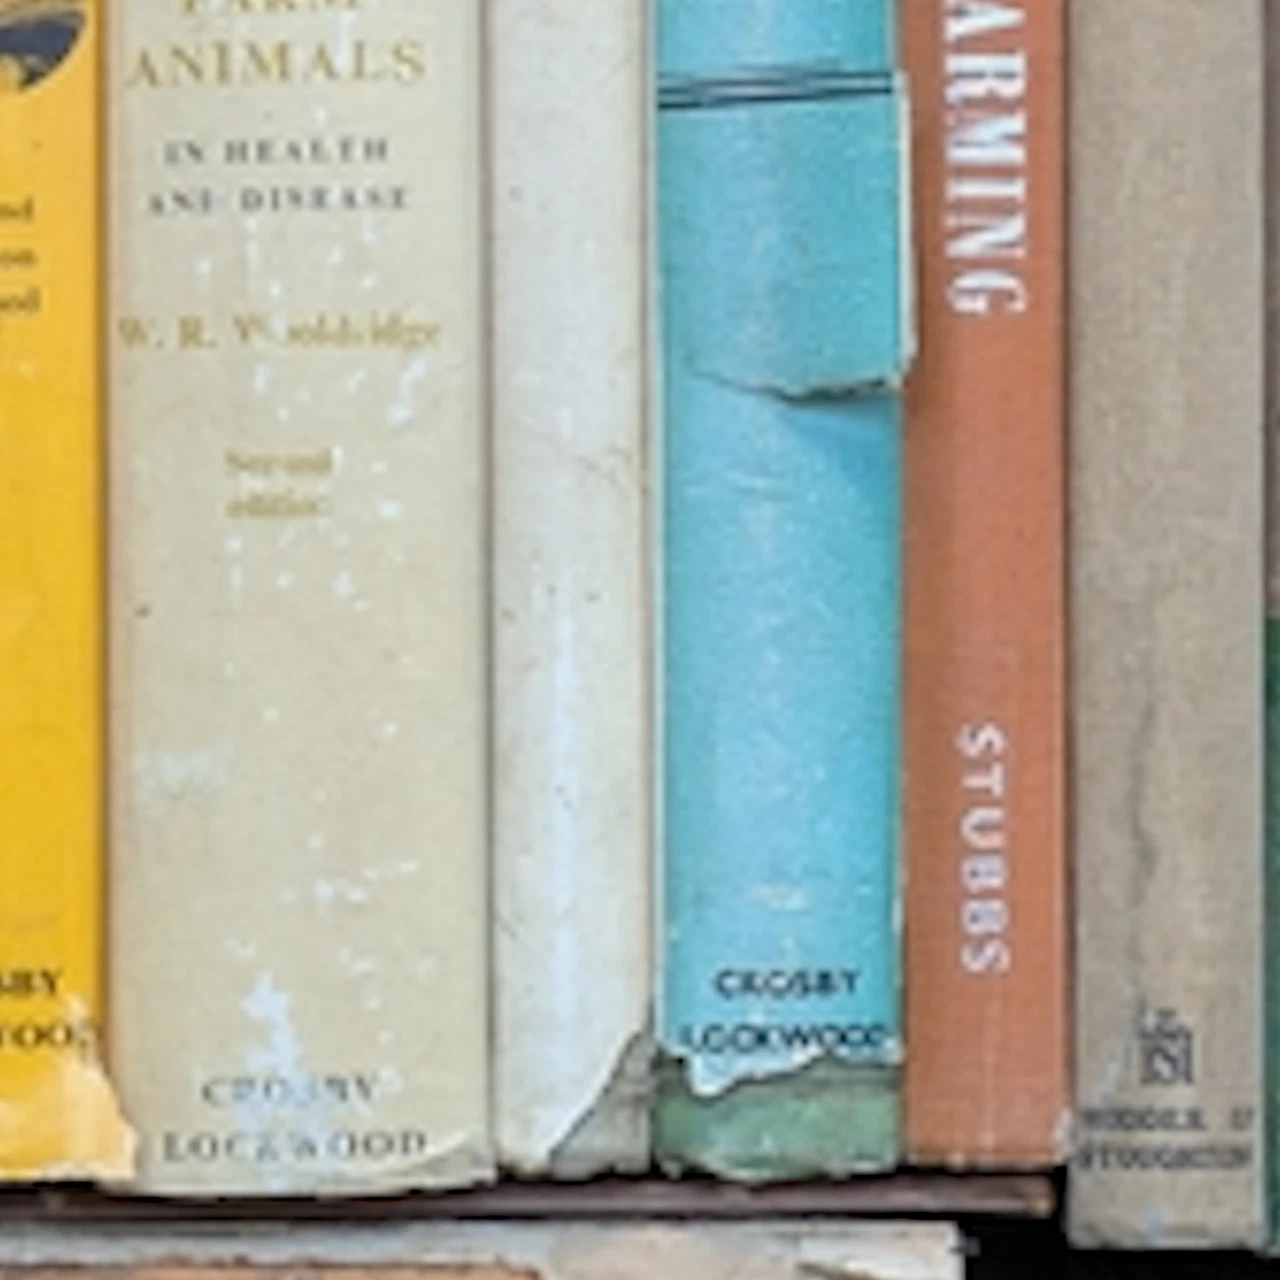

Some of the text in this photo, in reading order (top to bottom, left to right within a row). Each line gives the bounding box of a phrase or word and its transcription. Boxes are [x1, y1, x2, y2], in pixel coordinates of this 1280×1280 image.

[124, 39, 428, 89] ANIMALS
[164, 134, 391, 168] IN HEALTH
[239, 183, 412, 214] DISEASE
[957, 720, 1013, 974] STUBBS
